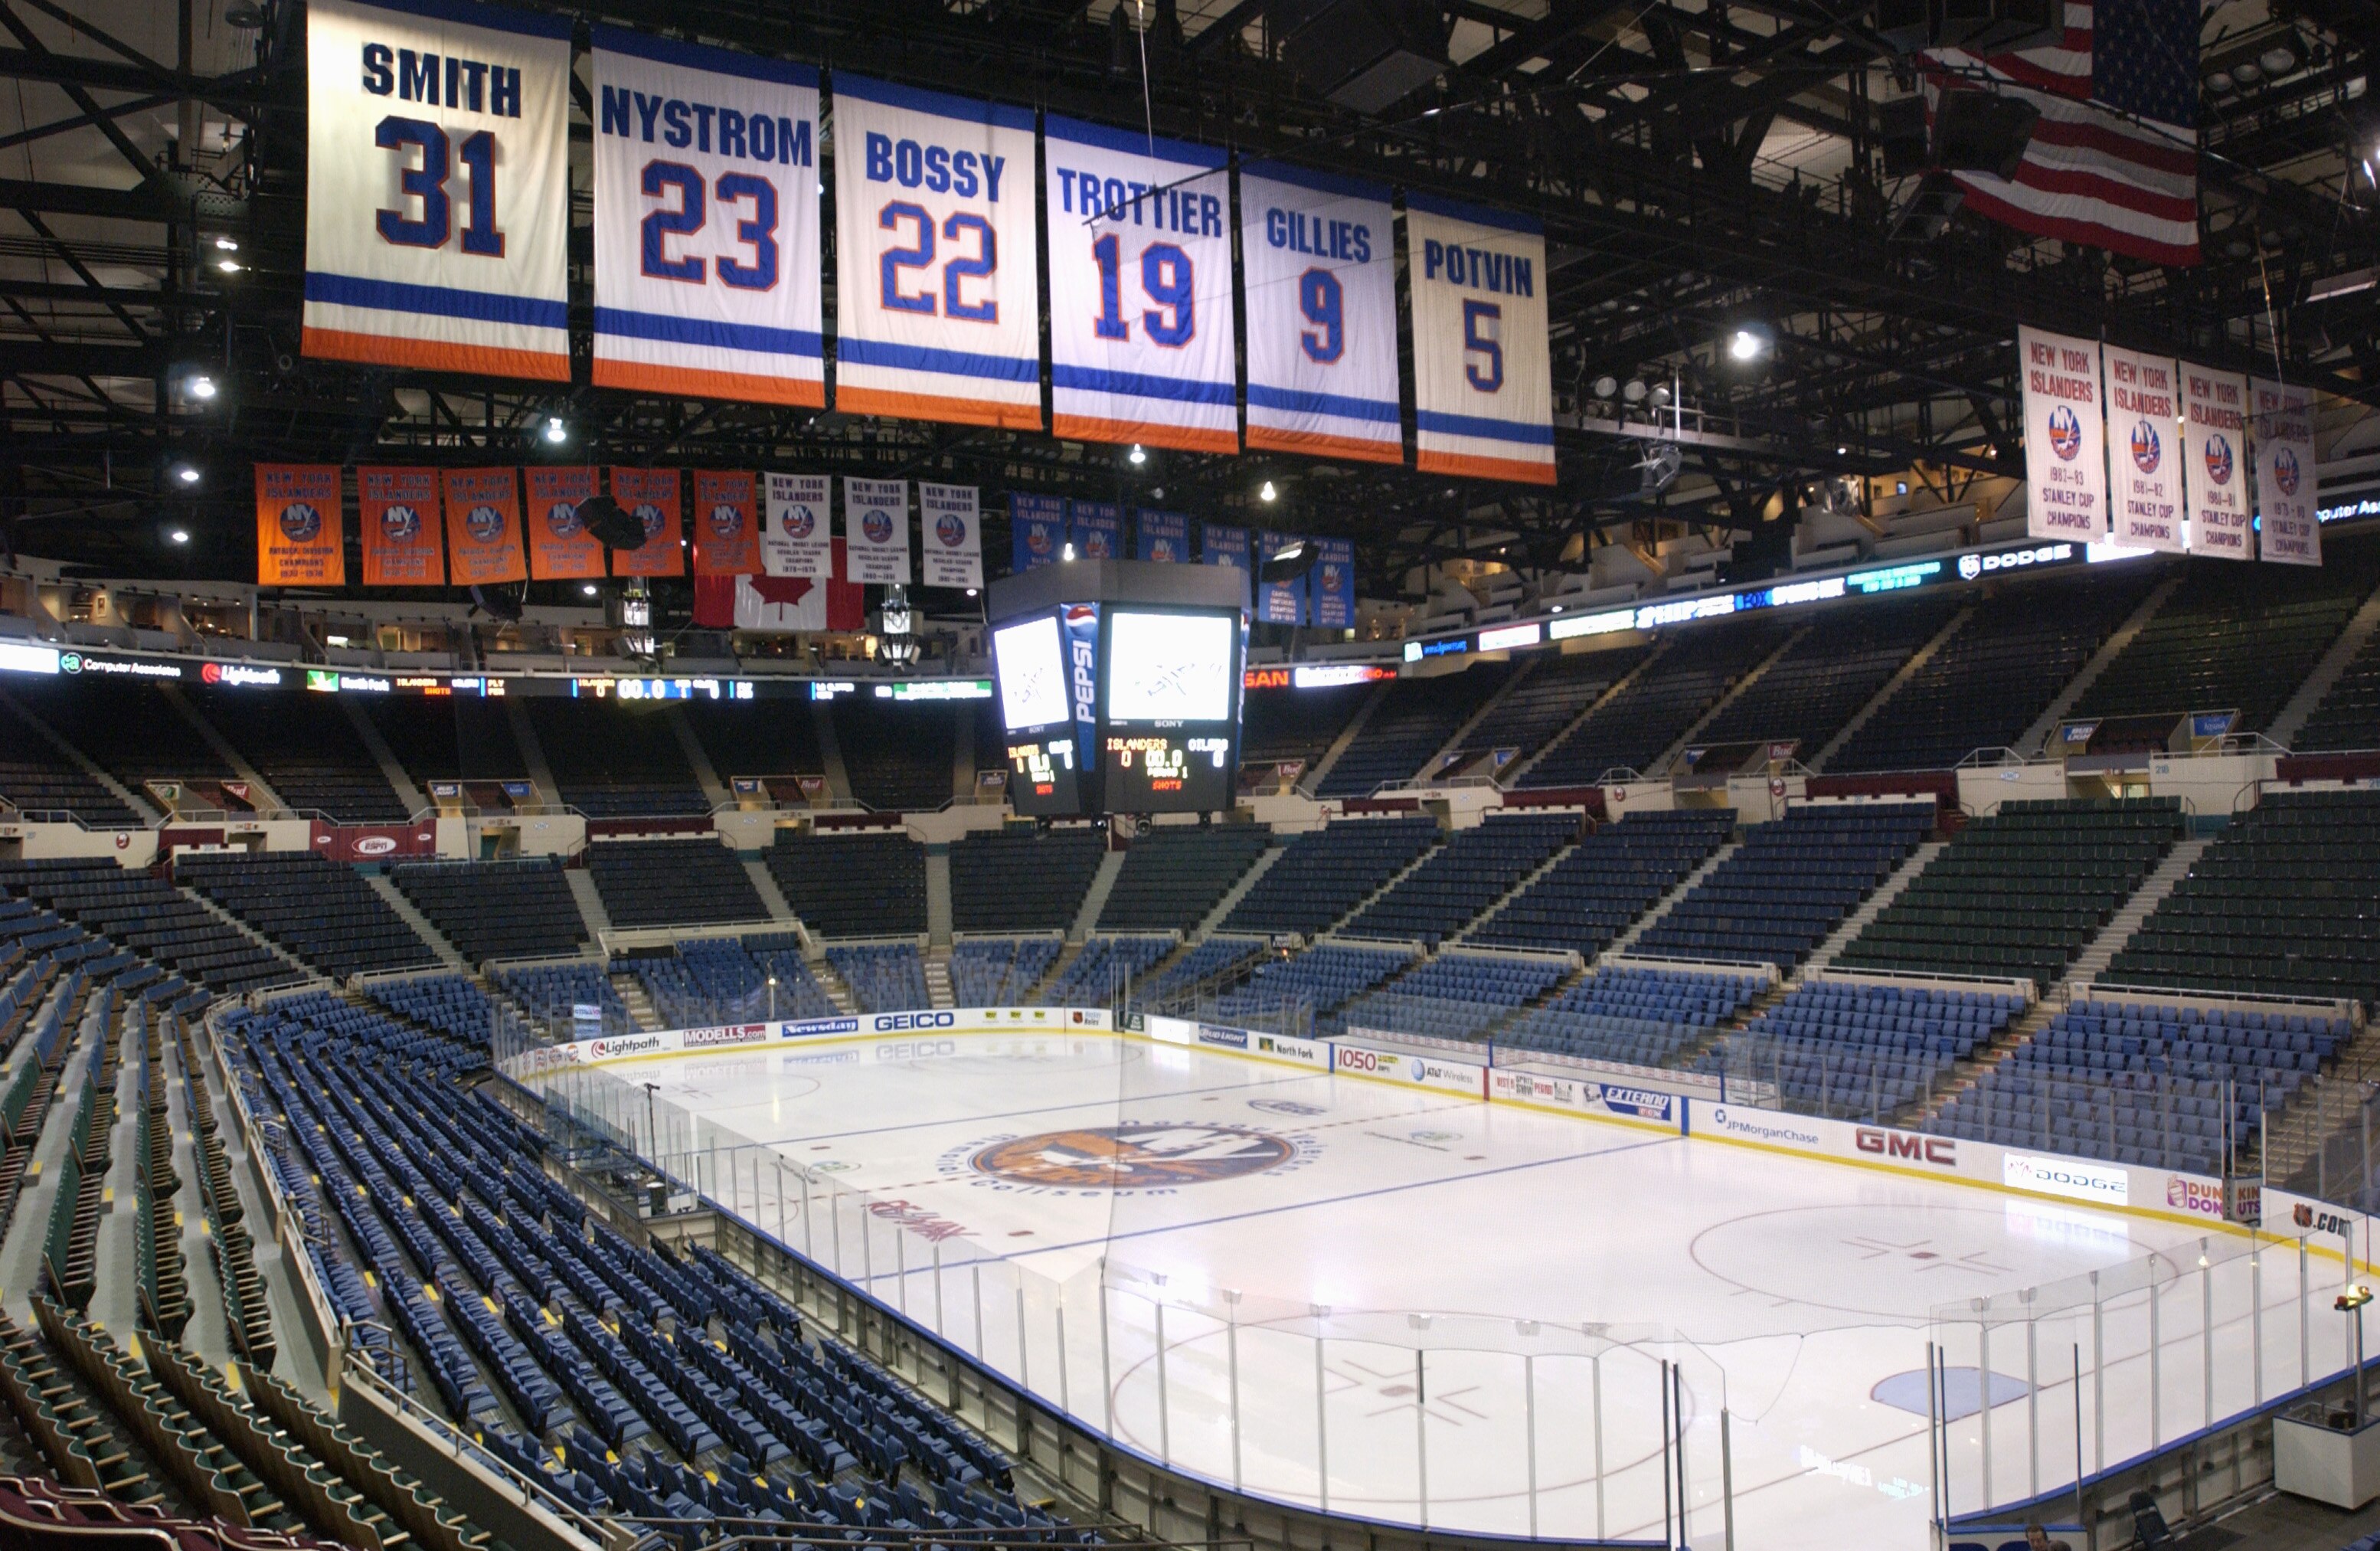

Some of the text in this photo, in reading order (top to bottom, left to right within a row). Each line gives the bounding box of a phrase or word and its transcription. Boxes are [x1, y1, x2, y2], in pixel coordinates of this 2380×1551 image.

[361, 42, 521, 118] SMITH
[601, 85, 812, 168] NYSTROM
[866, 130, 1005, 202] BOSSY
[375, 115, 505, 259] 31
[1057, 167, 1222, 237] TROTTIER
[640, 159, 779, 293] 23
[1267, 208, 1371, 263] GILLIES
[879, 199, 999, 325] 22
[1424, 238, 1534, 297] POTVIN
[1092, 232, 1197, 350] 19
[1299, 266, 1345, 366] 9
[1463, 298, 1504, 394] 5
[2031, 342, 2090, 374] NEW YORK
[2114, 359, 2168, 391] NEW YORK
[2031, 370, 2094, 403] ISLANDERS
[2189, 376, 2238, 404] NEW YORK
[2114, 388, 2172, 418] ISLANDERS
[2190, 403, 2243, 430] ISLANDERS
[267, 473, 332, 484] NEW YORK
[368, 475, 430, 486] NEW YORK
[535, 473, 591, 485] NEW YORK
[772, 477, 824, 489] NEW YORK
[266, 488, 332, 499] ISLANDERS
[368, 489, 431, 500] ISLANDERS
[537, 488, 591, 499] ISLANDERS
[772, 490, 823, 502] ISLANDERS
[852, 482, 901, 494] NEW YORK
[926, 487, 973, 499] NEW YORK
[852, 495, 901, 506] ISLANDERS
[926, 500, 973, 512] ISLANDERS
[1016, 497, 1061, 510] NEW YORK
[2043, 488, 2094, 508] STANLEY CUP
[1017, 509, 1060, 522] ISLANDERS
[2127, 500, 2174, 519] STANLEY CUP
[2202, 510, 2245, 526] STANLEY CUP
[1143, 512, 1184, 527] NEW YORK
[2047, 512, 2091, 530] CHAMPIONS
[1143, 524, 1184, 538] ISLANDERS
[2130, 522, 2170, 540] CHAMPIONS
[2205, 531, 2242, 547] CHAMPIONS
[1983, 545, 2071, 571] DODGE
[84, 659, 181, 677] Computer Associates
[221, 666, 280, 686] Lightpath
[619, 679, 665, 699] 00.0
[1072, 640, 1096, 724] PEPSI
[1107, 738, 1168, 751] ISLANDERS
[1774, 745, 1793, 756] Bud
[1121, 749, 1224, 767] 0 00.0 0
[801, 780, 820, 789] Bud
[1152, 780, 1182, 790] SHOTS
[784, 1021, 857, 1035] Newsday
[875, 1011, 954, 1031] GEICO
[1200, 1028, 1246, 1043] BUD LIGHT
[606, 1036, 659, 1056] Lightpath
[1277, 1044, 1313, 1059] North Fork
[1339, 1049, 1376, 1071] 1050
[1427, 1067, 1473, 1084] AT&T Wireless
[1726, 1120, 1819, 1145] JPMorganChase
[1855, 1127, 1957, 1166] GMC
[2035, 1169, 2126, 1193] DODGE
